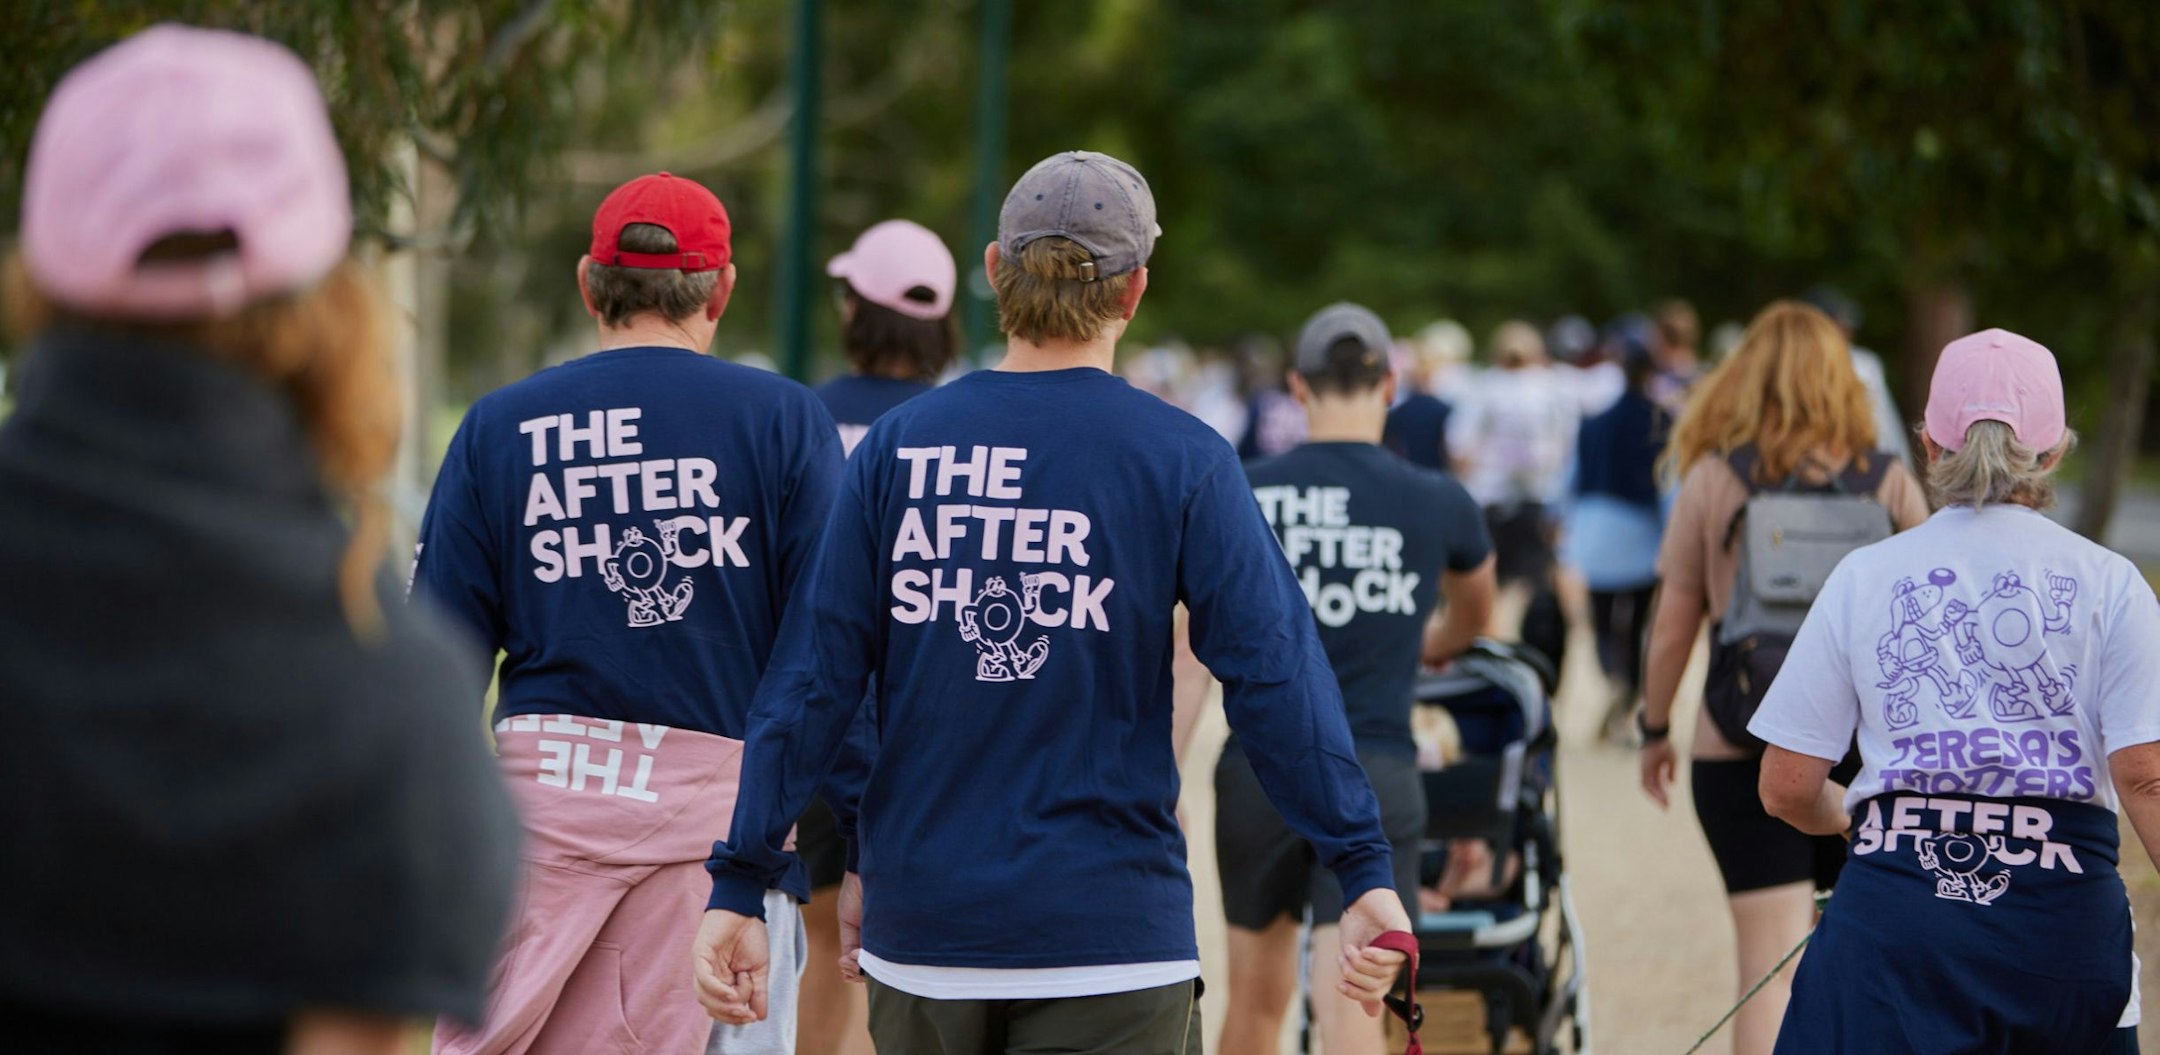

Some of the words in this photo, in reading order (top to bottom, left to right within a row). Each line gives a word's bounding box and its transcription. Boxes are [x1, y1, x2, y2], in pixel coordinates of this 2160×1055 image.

[519, 407, 643, 467] THE
[523, 457, 721, 527] AFTER
[896, 445, 1028, 499] THE
[892, 504, 1091, 567] AFTER
[1252, 485, 1351, 527] THE
[1283, 524, 1404, 571] FTER
[1296, 565, 1421, 628] OCK
[494, 713, 670, 750] AFT
[536, 739, 659, 804] THE
